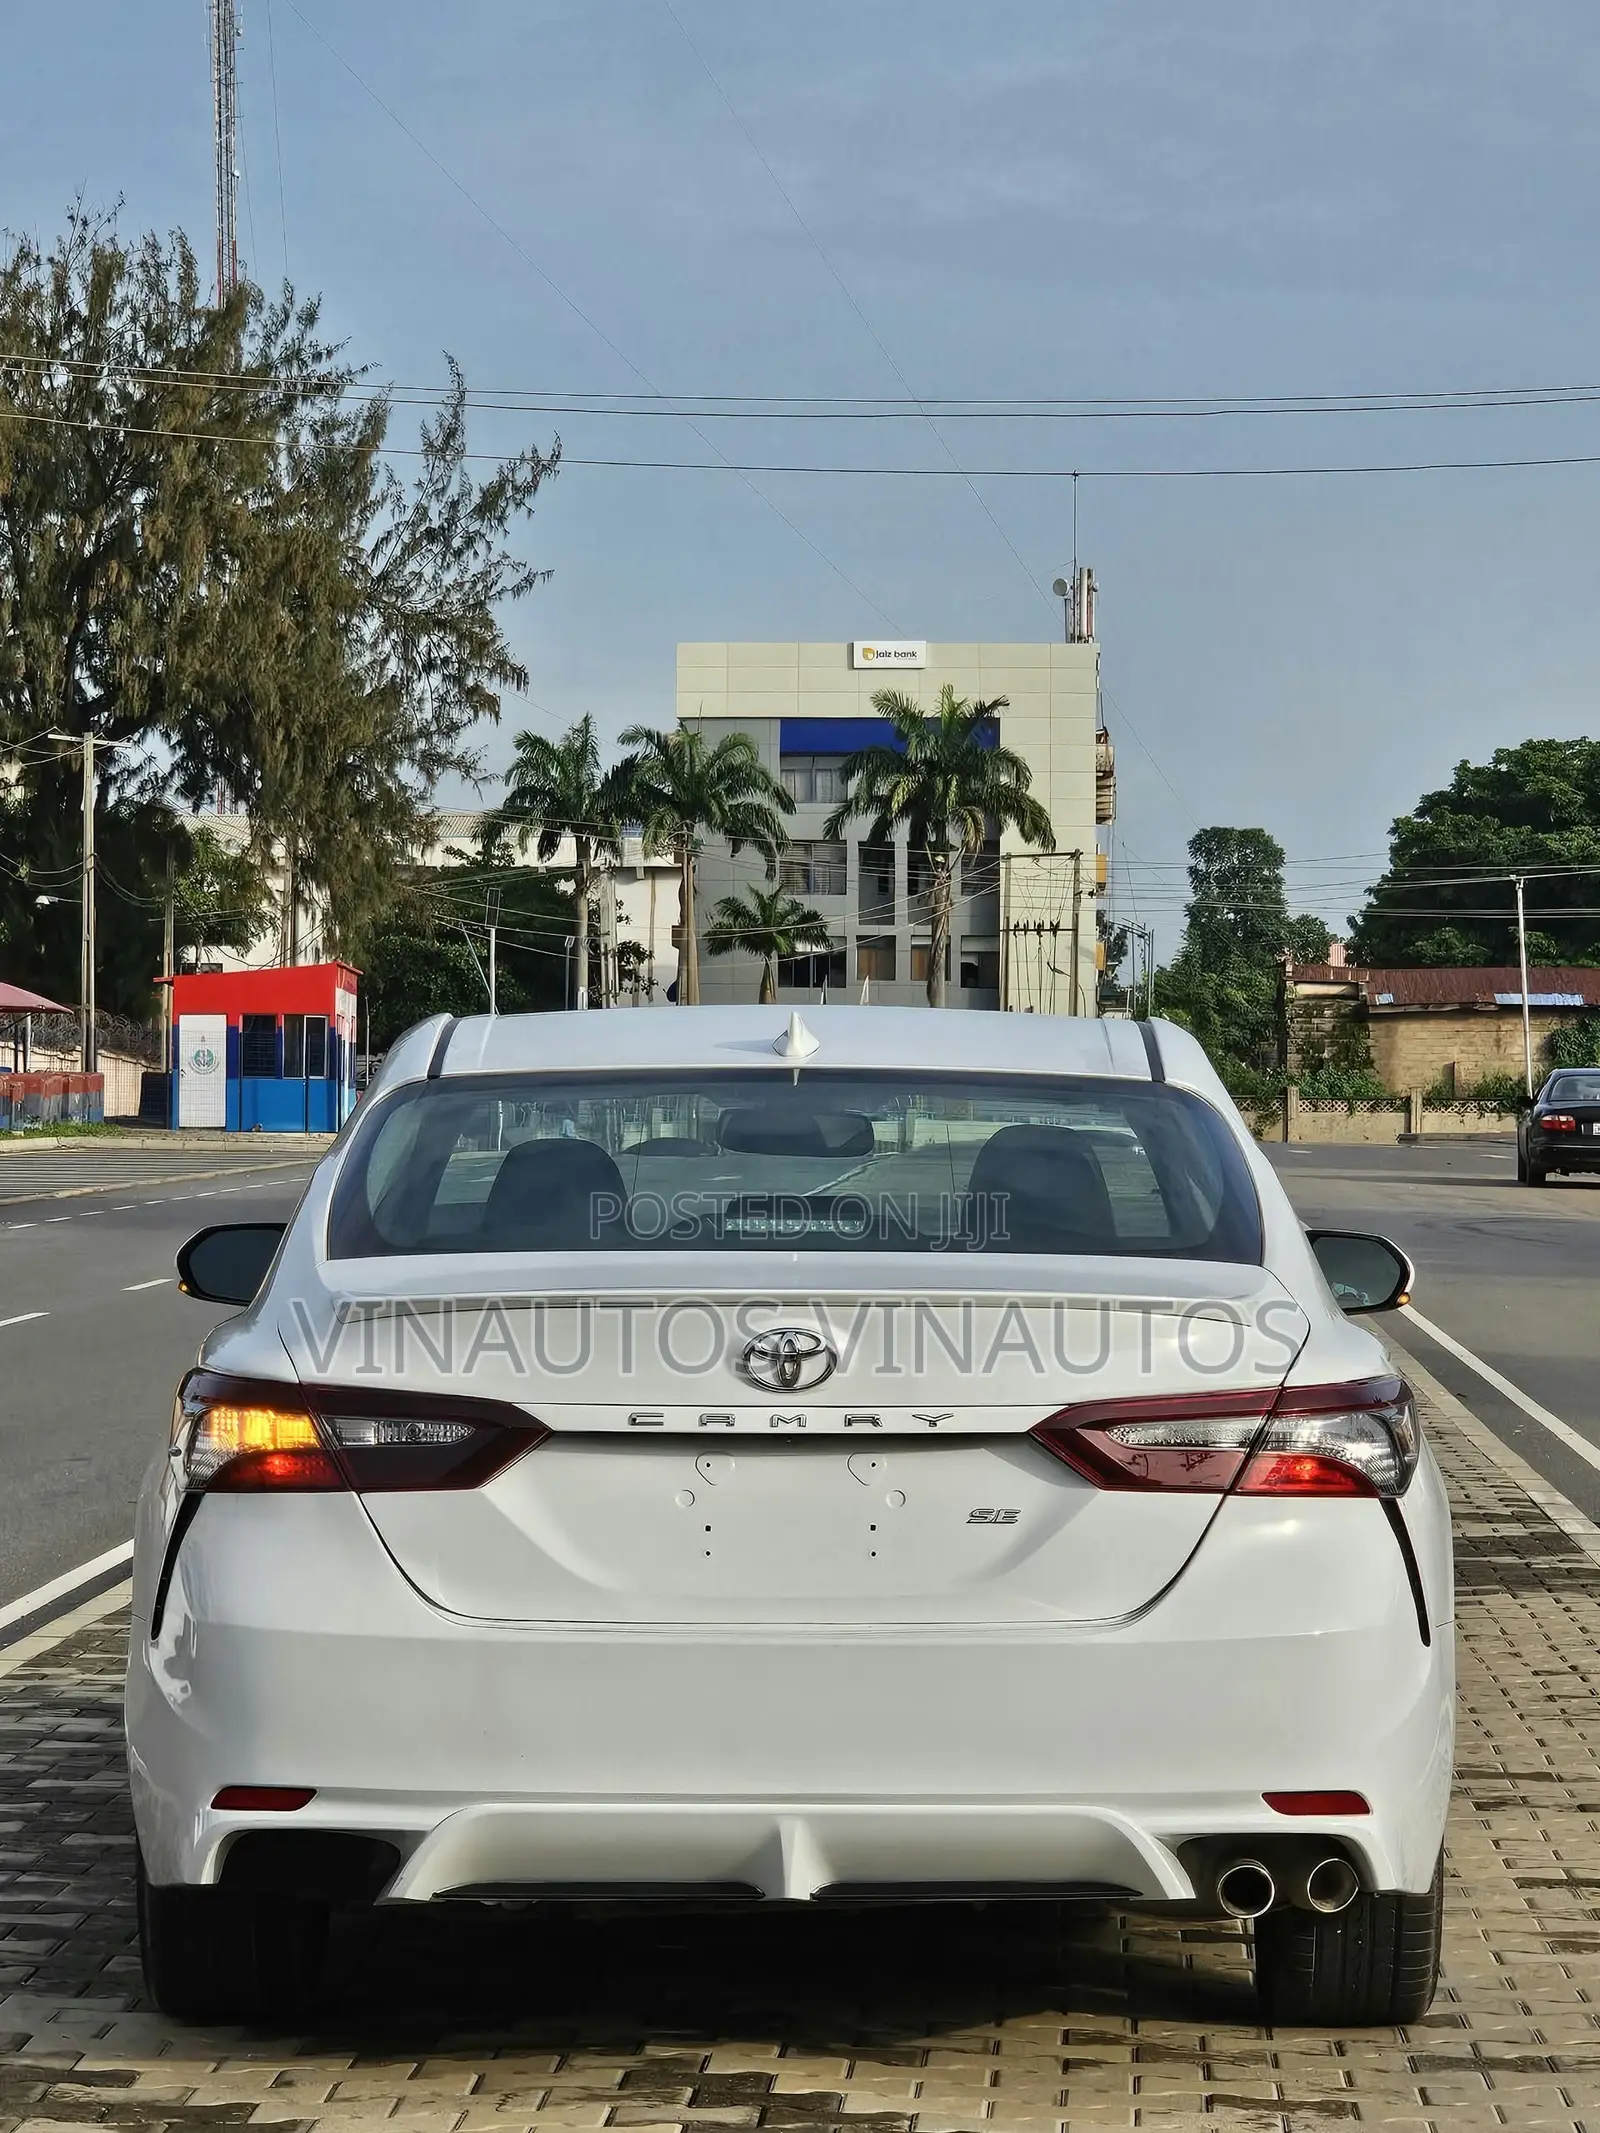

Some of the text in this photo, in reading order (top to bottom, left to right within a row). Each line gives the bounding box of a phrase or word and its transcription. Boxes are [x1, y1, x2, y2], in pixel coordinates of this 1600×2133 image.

[894, 649, 917, 658] bank
[627, 1412, 955, 1429] CAMRY
[965, 1508, 1022, 1524] SE
